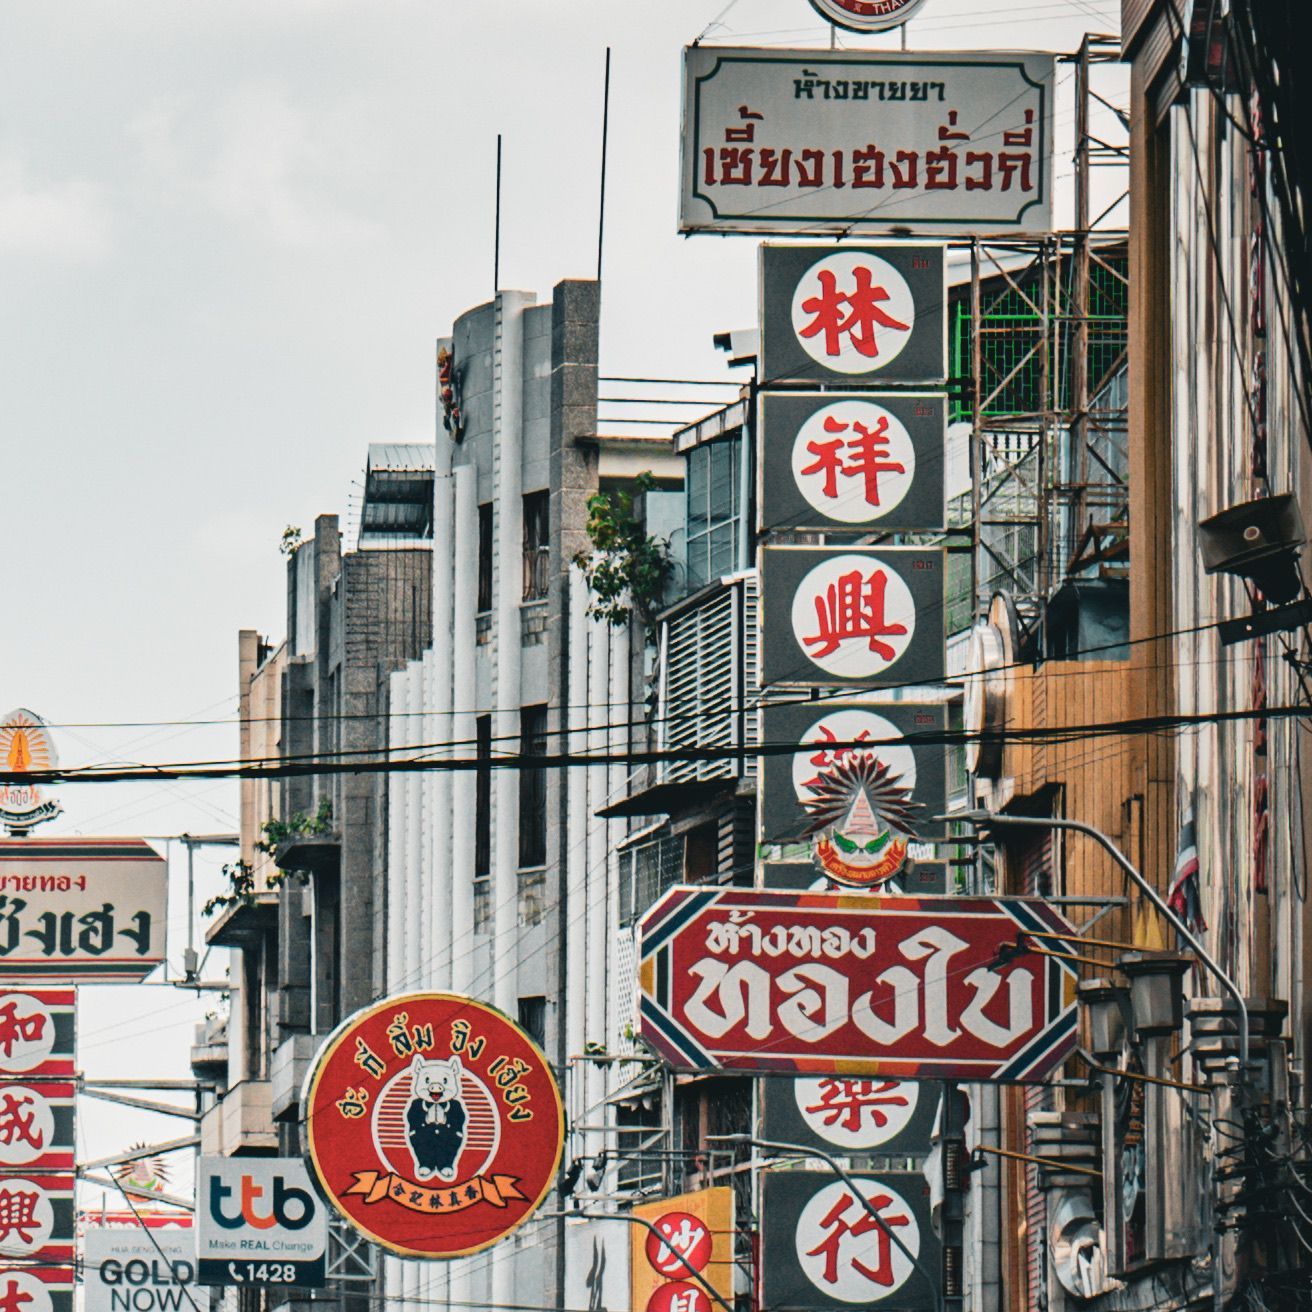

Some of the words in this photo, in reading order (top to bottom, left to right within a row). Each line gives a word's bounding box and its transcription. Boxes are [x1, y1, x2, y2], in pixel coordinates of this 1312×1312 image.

[793, 69, 947, 104] ห้างขายยา
[706, 909, 877, 958] ห้างทอง
[210, 1175, 316, 1231] ttb
[208, 1239, 236, 1249] Make
[239, 1239, 270, 1250] REAL
[272, 1239, 314, 1252] Change
[99, 1258, 194, 1288] GOLD
[247, 1263, 296, 1283] 1428
[110, 1287, 183, 1312] NOW
